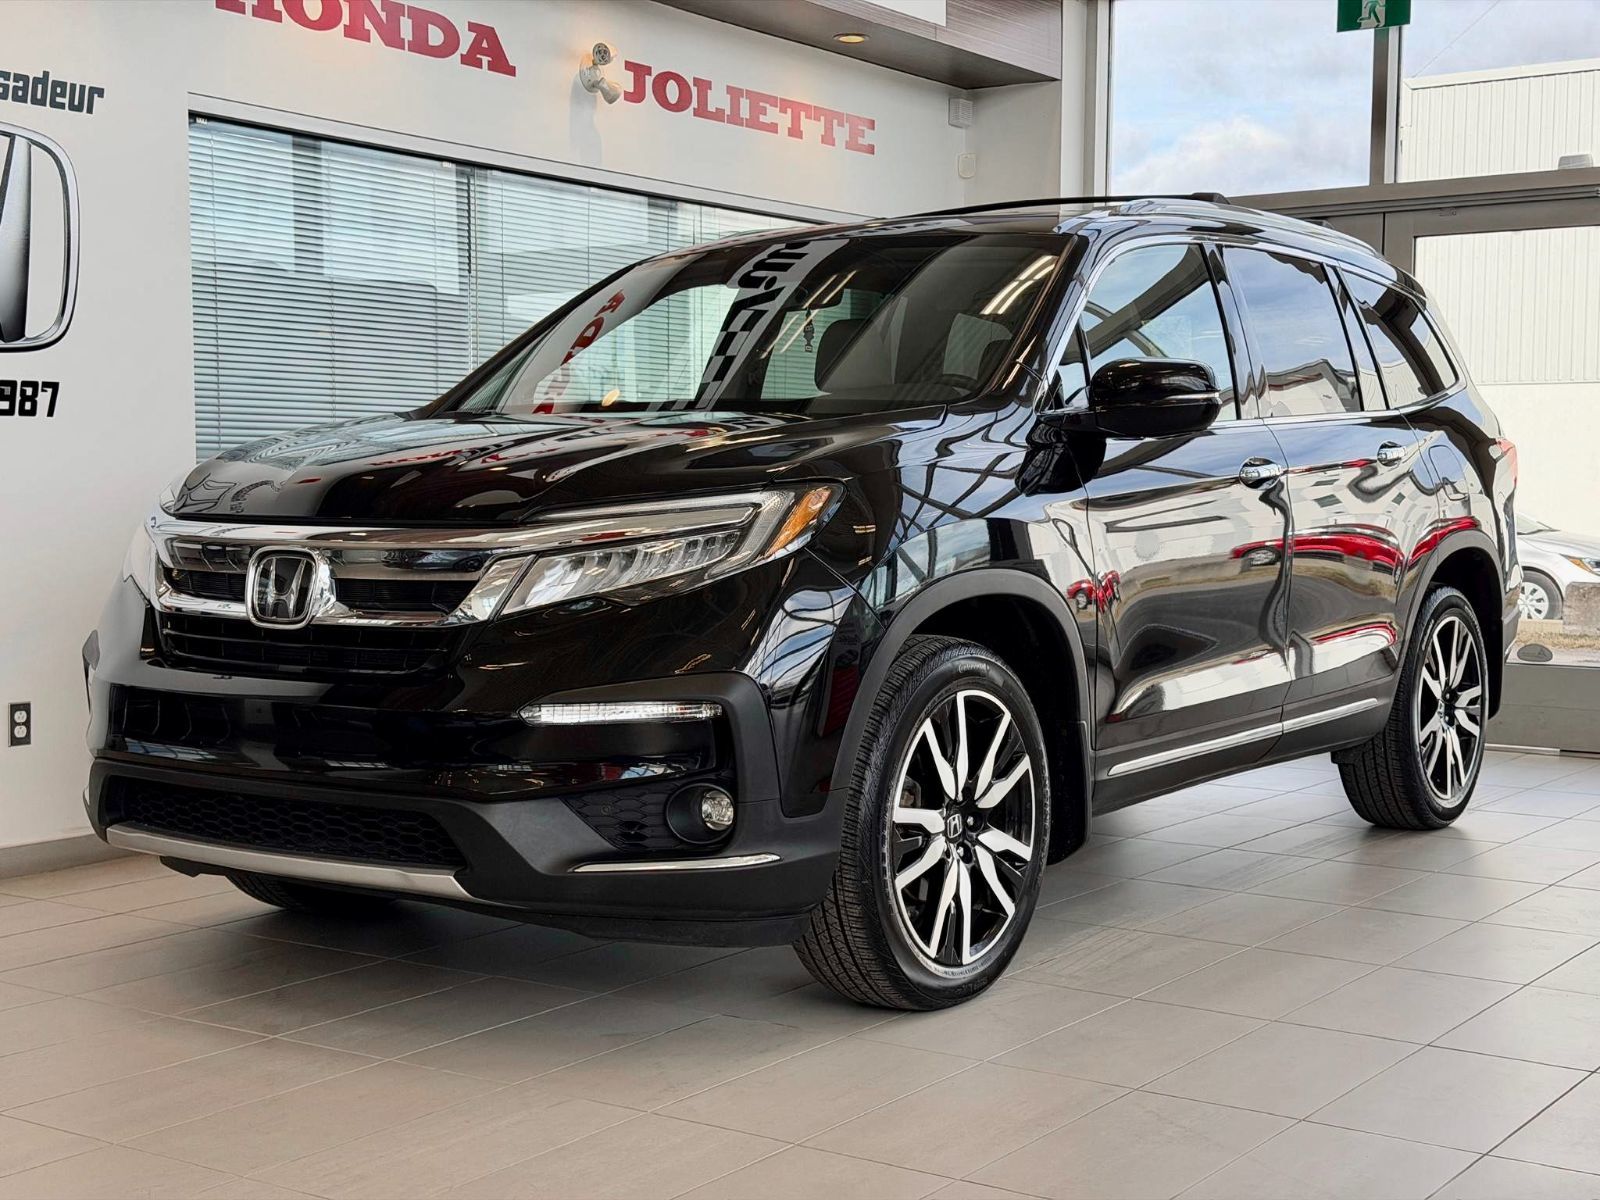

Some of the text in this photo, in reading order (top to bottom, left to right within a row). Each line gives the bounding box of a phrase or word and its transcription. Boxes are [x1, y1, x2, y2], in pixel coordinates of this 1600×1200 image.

[0, 70, 105, 115] sadeur
[215, 0, 876, 156] ONDA JOLIETTE
[0, 380, 60, 417] 987
